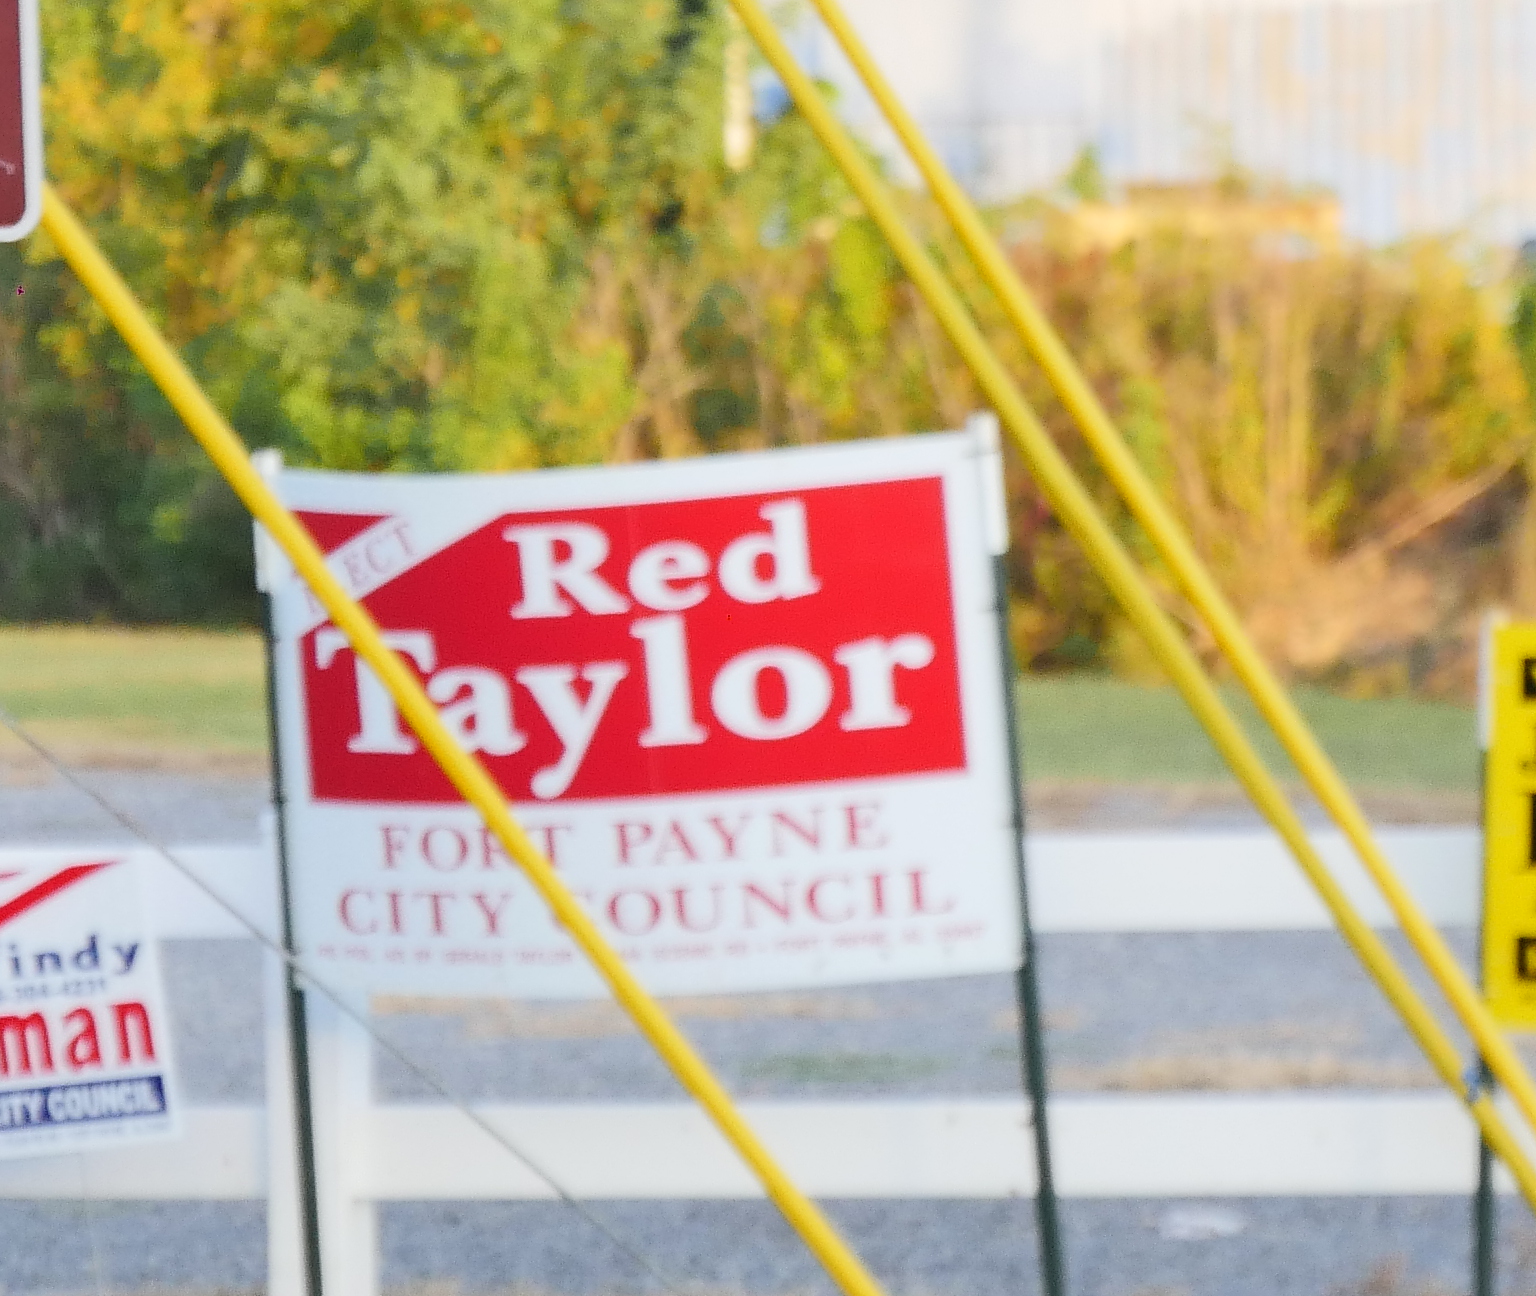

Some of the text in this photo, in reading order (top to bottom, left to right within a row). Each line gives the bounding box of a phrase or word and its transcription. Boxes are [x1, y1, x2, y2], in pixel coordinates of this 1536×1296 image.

[503, 498, 820, 618] Red
[316, 613, 935, 799] Taylor
[613, 801, 889, 866] PAYNE
[337, 870, 956, 936] CITY OUNCIL
[47, 1079, 152, 1123] COUNCIL
